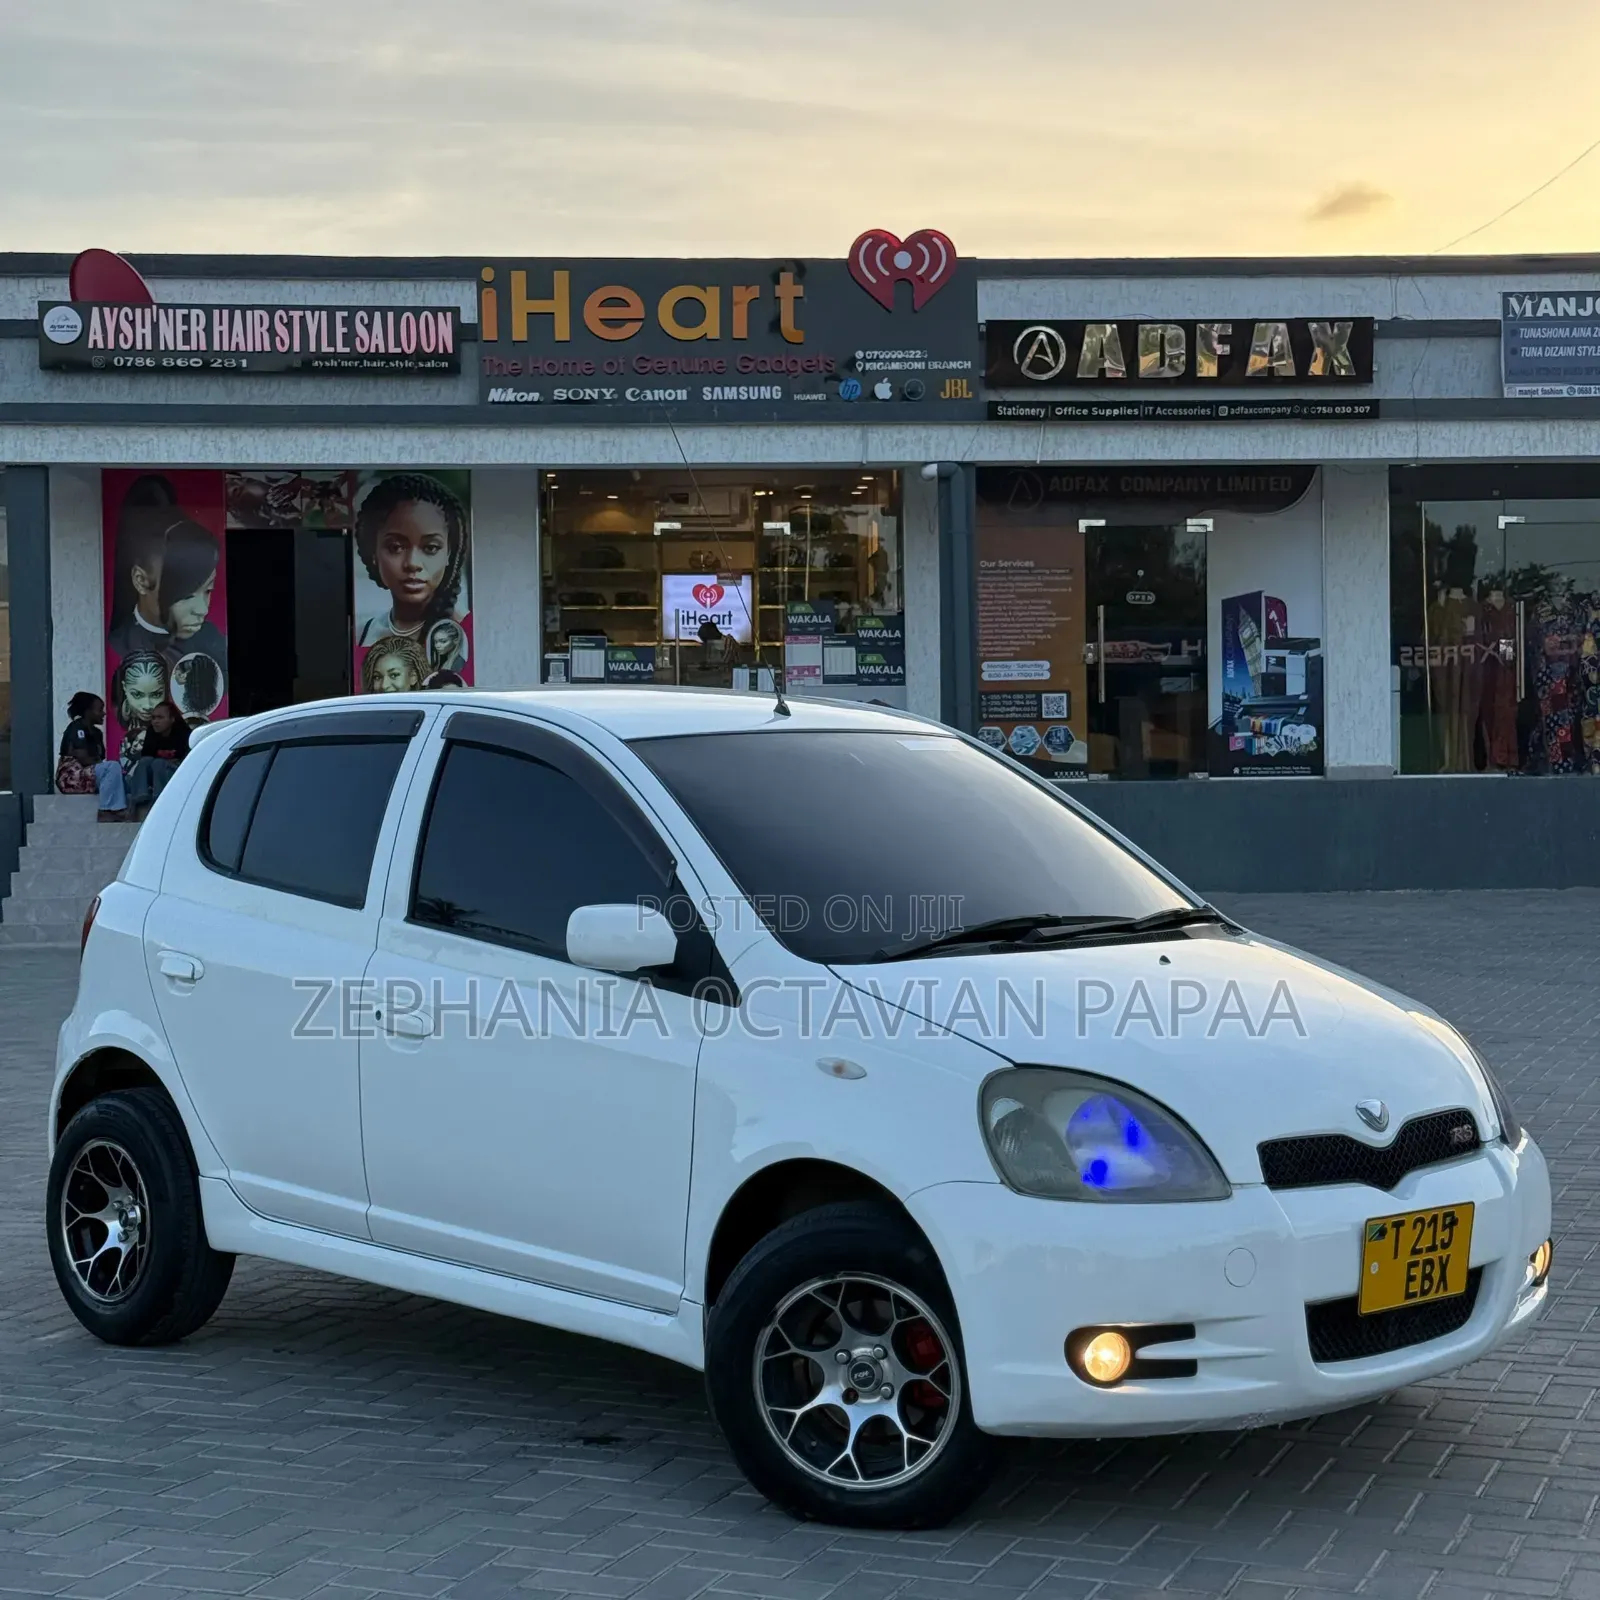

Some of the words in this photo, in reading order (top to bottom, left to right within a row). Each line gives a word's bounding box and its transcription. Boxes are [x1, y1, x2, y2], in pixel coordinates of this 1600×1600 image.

[482, 266, 804, 344] iHeart
[88, 304, 207, 352] AYSH'NER
[213, 308, 271, 353] HAIR
[274, 309, 351, 354] STYLE
[355, 310, 454, 355] SALOON
[1519, 327, 1570, 339] TUNASHONA
[1571, 327, 1593, 338] AINA
[1075, 321, 1356, 380] ADFAX
[1521, 346, 1543, 358] TUNA
[1543, 346, 1576, 357] DIZAINI
[113, 356, 157, 368] 0786
[162, 357, 204, 369] 860
[209, 357, 249, 369] 281
[483, 355, 523, 377] The
[529, 355, 596, 377] Home
[602, 355, 627, 376] of
[633, 354, 727, 376] Genuine
[736, 352, 837, 379] Gadgets
[865, 361, 926, 371] KIGAMBONI
[928, 360, 972, 370] BRANCH
[487, 387, 541, 403] Nikon
[553, 388, 617, 401] SONY
[624, 387, 688, 402] Canon
[702, 385, 782, 402] SAMSUNG
[841, 380, 860, 399] hp
[940, 379, 974, 399] JBL
[792, 393, 827, 401] HUAWEI
[996, 405, 1046, 418] Stationery
[1054, 406, 1089, 416] Office
[1090, 406, 1138, 418] Supplies
[1144, 406, 1154, 416] IT
[1229, 405, 1292, 417] adfaxcompany
[1334, 406, 1352, 414] 030
[1353, 405, 1371, 414] 307
[1049, 476, 1110, 493] ADFAX
[1120, 476, 1210, 493] COMPANY
[1217, 475, 1293, 492] LIMITED
[979, 560, 996, 569] Our
[997, 559, 1035, 569] Services
[1127, 594, 1154, 602] OPEN
[681, 610, 733, 626] iHeart
[787, 615, 832, 625] WAKALA
[857, 629, 902, 639] WAKALA
[608, 662, 654, 673] WAKALA
[858, 665, 904, 675] WAKALA
[986, 663, 1012, 671] Monday
[1016, 662, 1045, 671] Saturday
[1390, 1219, 1406, 1260] T
[1409, 1210, 1460, 1256] 215
[1404, 1254, 1452, 1301] EBX
